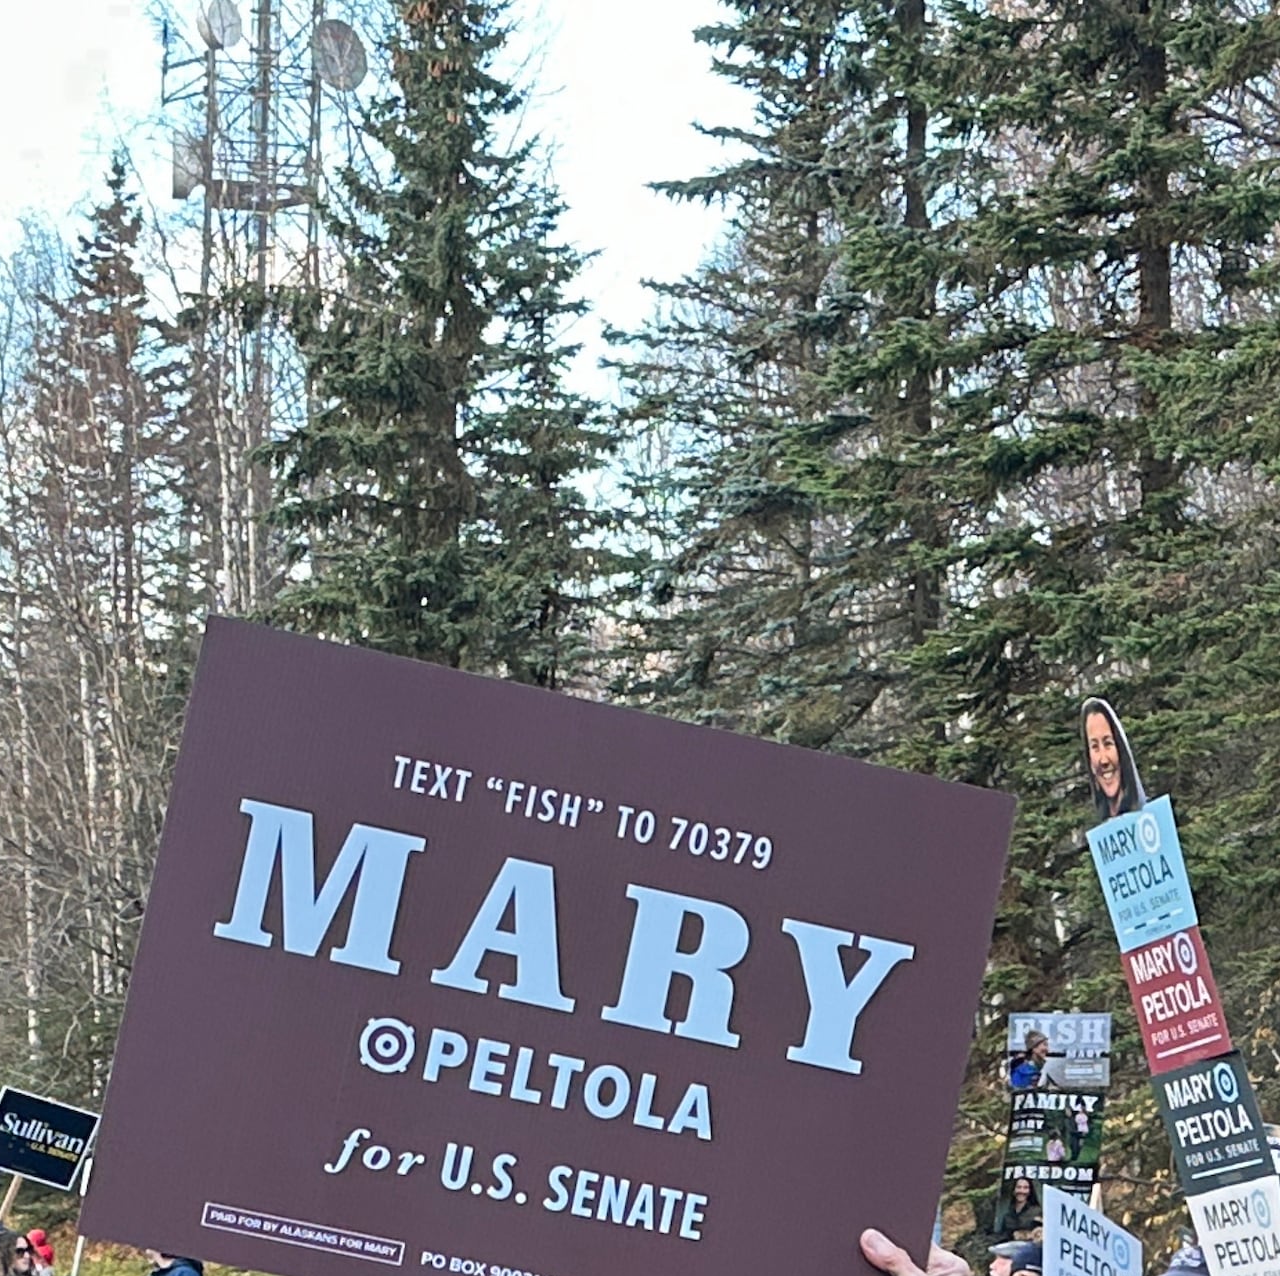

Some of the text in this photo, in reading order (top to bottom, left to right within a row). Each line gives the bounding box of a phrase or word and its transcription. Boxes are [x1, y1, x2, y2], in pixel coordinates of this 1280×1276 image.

[393, 755, 472, 802] TEXT
[617, 805, 656, 843] TO
[669, 816, 773, 870] 70379
[1098, 824, 1137, 865] MARY
[1109, 854, 1174, 901] PELTOLA
[1150, 888, 1180, 910] SENATE
[213, 797, 914, 1075] MARY
[1130, 942, 1175, 984] MARY
[1141, 976, 1212, 1024] PELTOLA
[1014, 1018, 1105, 1044] FISH
[1151, 1029, 1170, 1046] FOR
[1187, 1013, 1219, 1034] SENATE
[423, 1028, 712, 1140] PELTOLA
[1013, 1093, 1098, 1112] FAMILY
[1164, 1071, 1213, 1110] MARY
[0, 1112, 84, 1155] Sullivan
[1175, 1104, 1253, 1148] PELTOLA
[1005, 1166, 1093, 1181] FREEDOM
[1185, 1151, 1205, 1168] FOR
[1206, 1148, 1224, 1163] U.S.
[1225, 1138, 1260, 1158] SENATE
[324, 1128, 708, 1241] for U.S. SENATE
[210, 1210, 397, 1257] PAID FOR BY ALASKANS FOR MARY
[1060, 1203, 1110, 1251] MARY
[1204, 1196, 1251, 1231] MARY
[421, 1252, 446, 1269] PO
